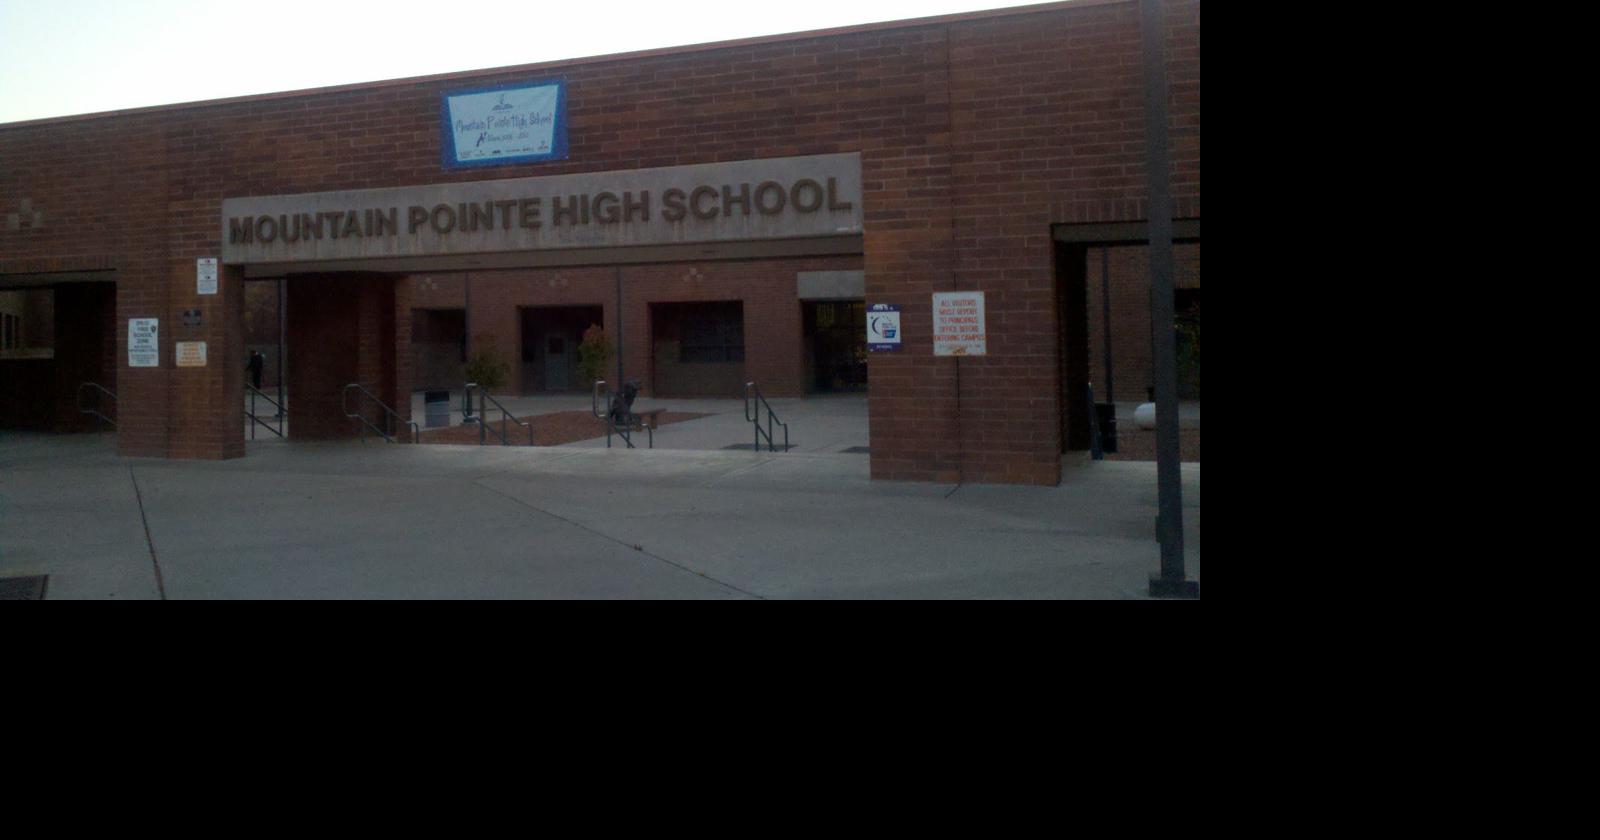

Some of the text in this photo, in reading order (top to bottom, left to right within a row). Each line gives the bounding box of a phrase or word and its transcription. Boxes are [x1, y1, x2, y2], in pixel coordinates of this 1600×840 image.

[229, 177, 852, 245] MOUNTAIN POINTE HIGH SCHOOL
